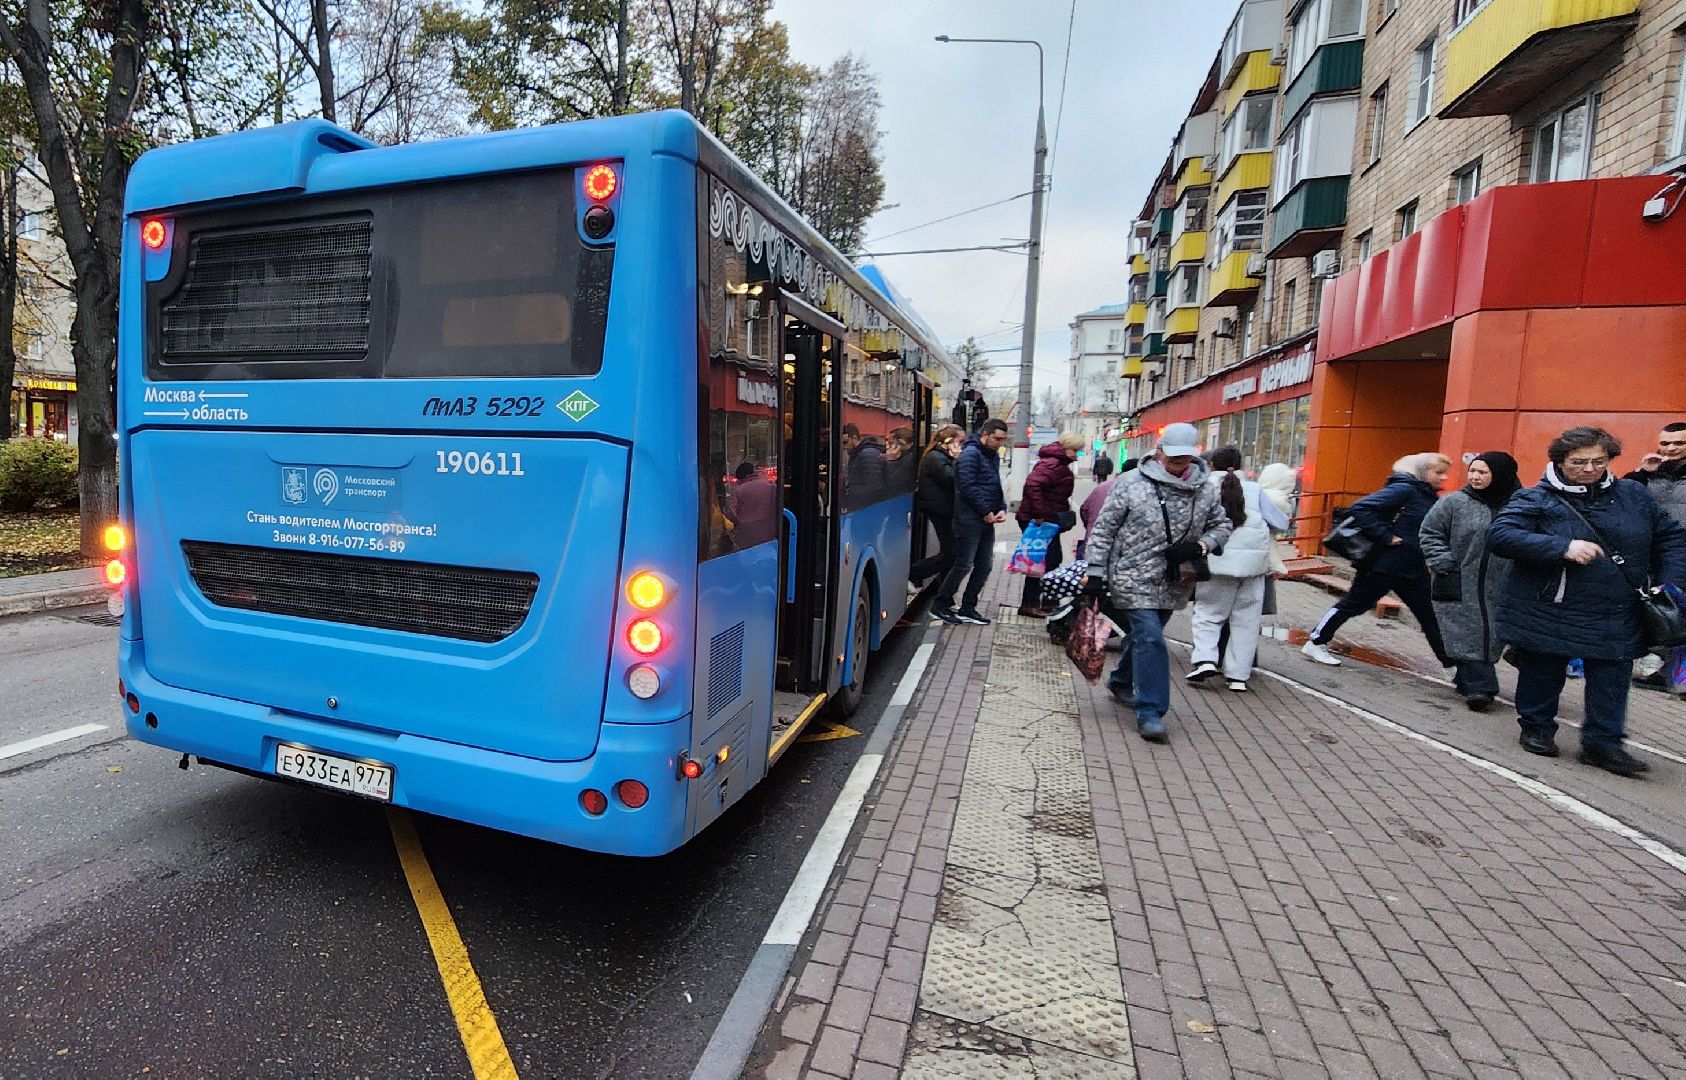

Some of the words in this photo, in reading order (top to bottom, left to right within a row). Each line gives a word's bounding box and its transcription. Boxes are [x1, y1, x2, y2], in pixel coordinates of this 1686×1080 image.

[144, 386, 196, 403] Москва
[191, 403, 248, 420] область
[485, 396, 545, 417] 5292
[565, 400, 589, 413] КПГ
[436, 450, 524, 475] 190611
[344, 475, 396, 487] Московский
[344, 487, 387, 498] транспорт
[247, 511, 277, 525] Стань
[279, 514, 340, 530] водителем
[342, 517, 437, 537] Мосгортранса!
[273, 530, 306, 544] Звони
[308, 533, 405, 553] 8-916-077-56-89
[283, 754, 350, 786] Е933ЕА
[356, 765, 385, 787] 977
[362, 784, 377, 794] RUS
